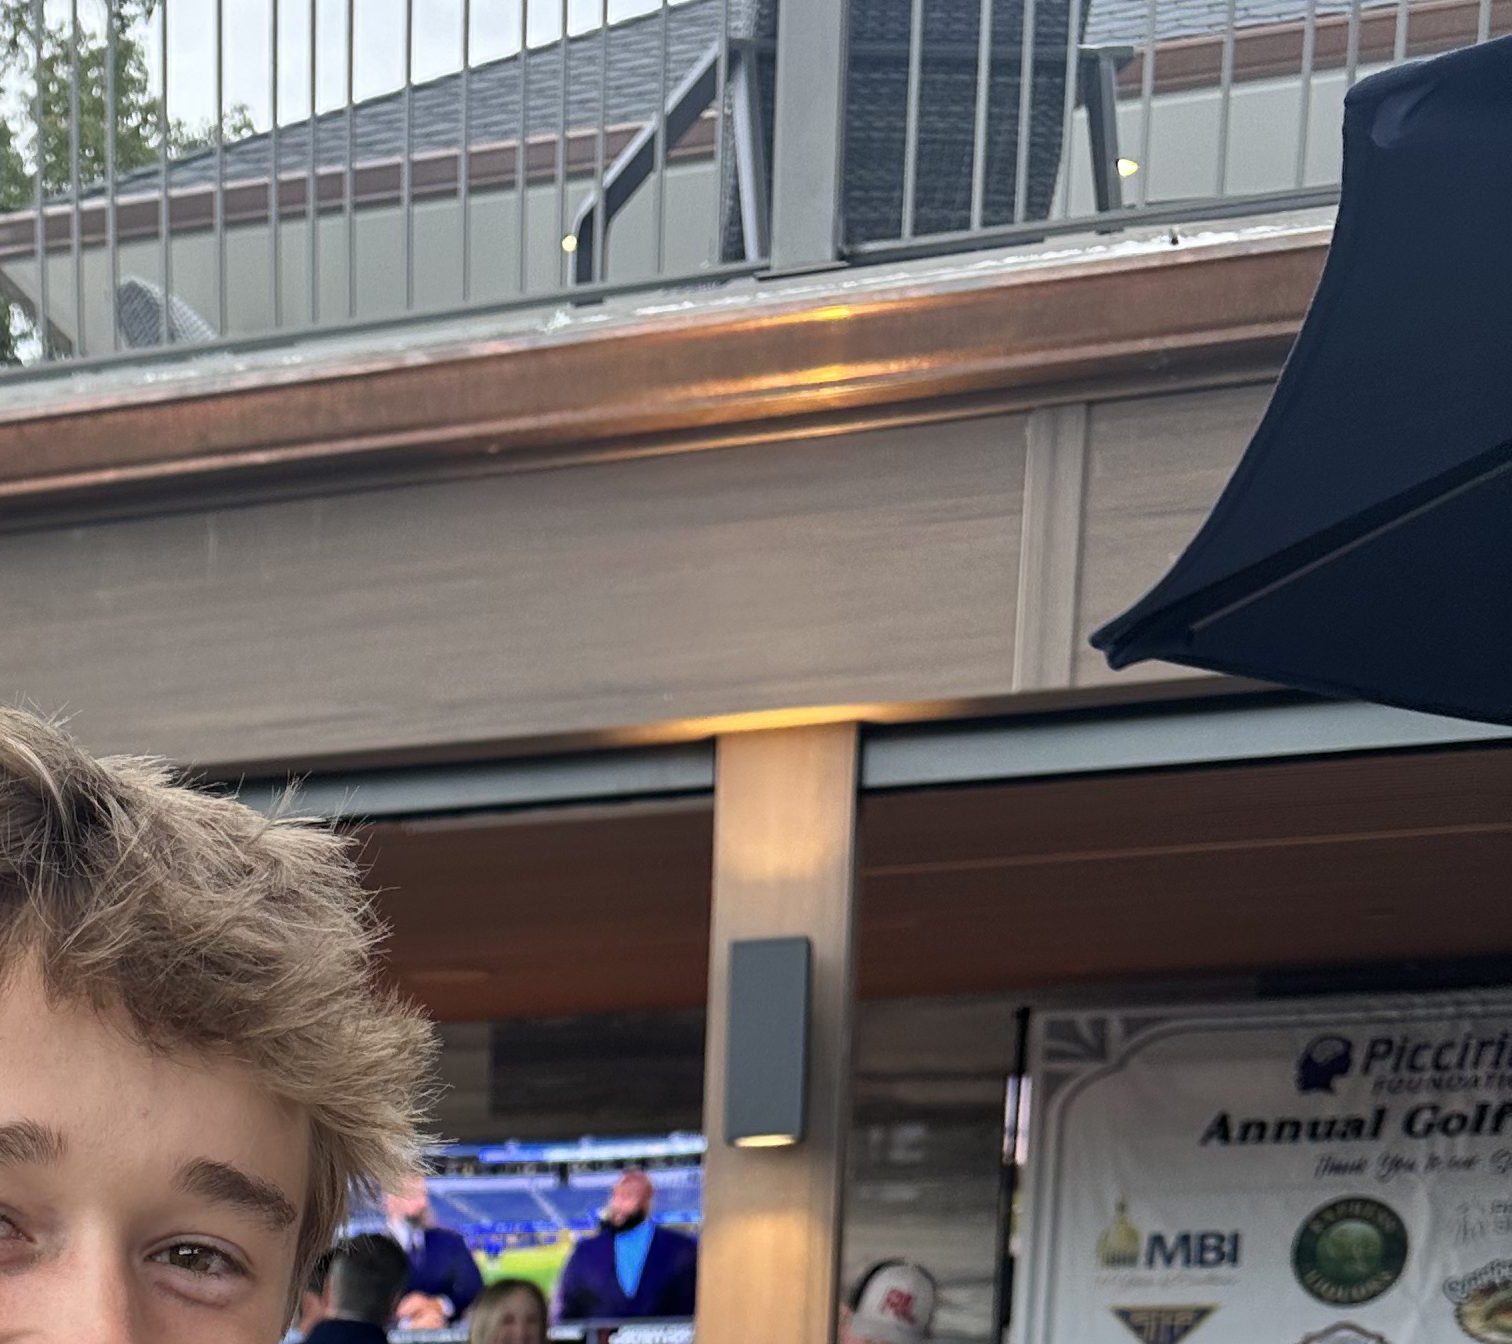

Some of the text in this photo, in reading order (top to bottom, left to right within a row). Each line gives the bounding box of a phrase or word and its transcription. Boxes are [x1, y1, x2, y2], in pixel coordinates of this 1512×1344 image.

[1360, 1030, 1512, 1075] Picciri
[1199, 1102, 1512, 1146] Annual Golf
[1144, 1229, 1242, 1271] MBI
